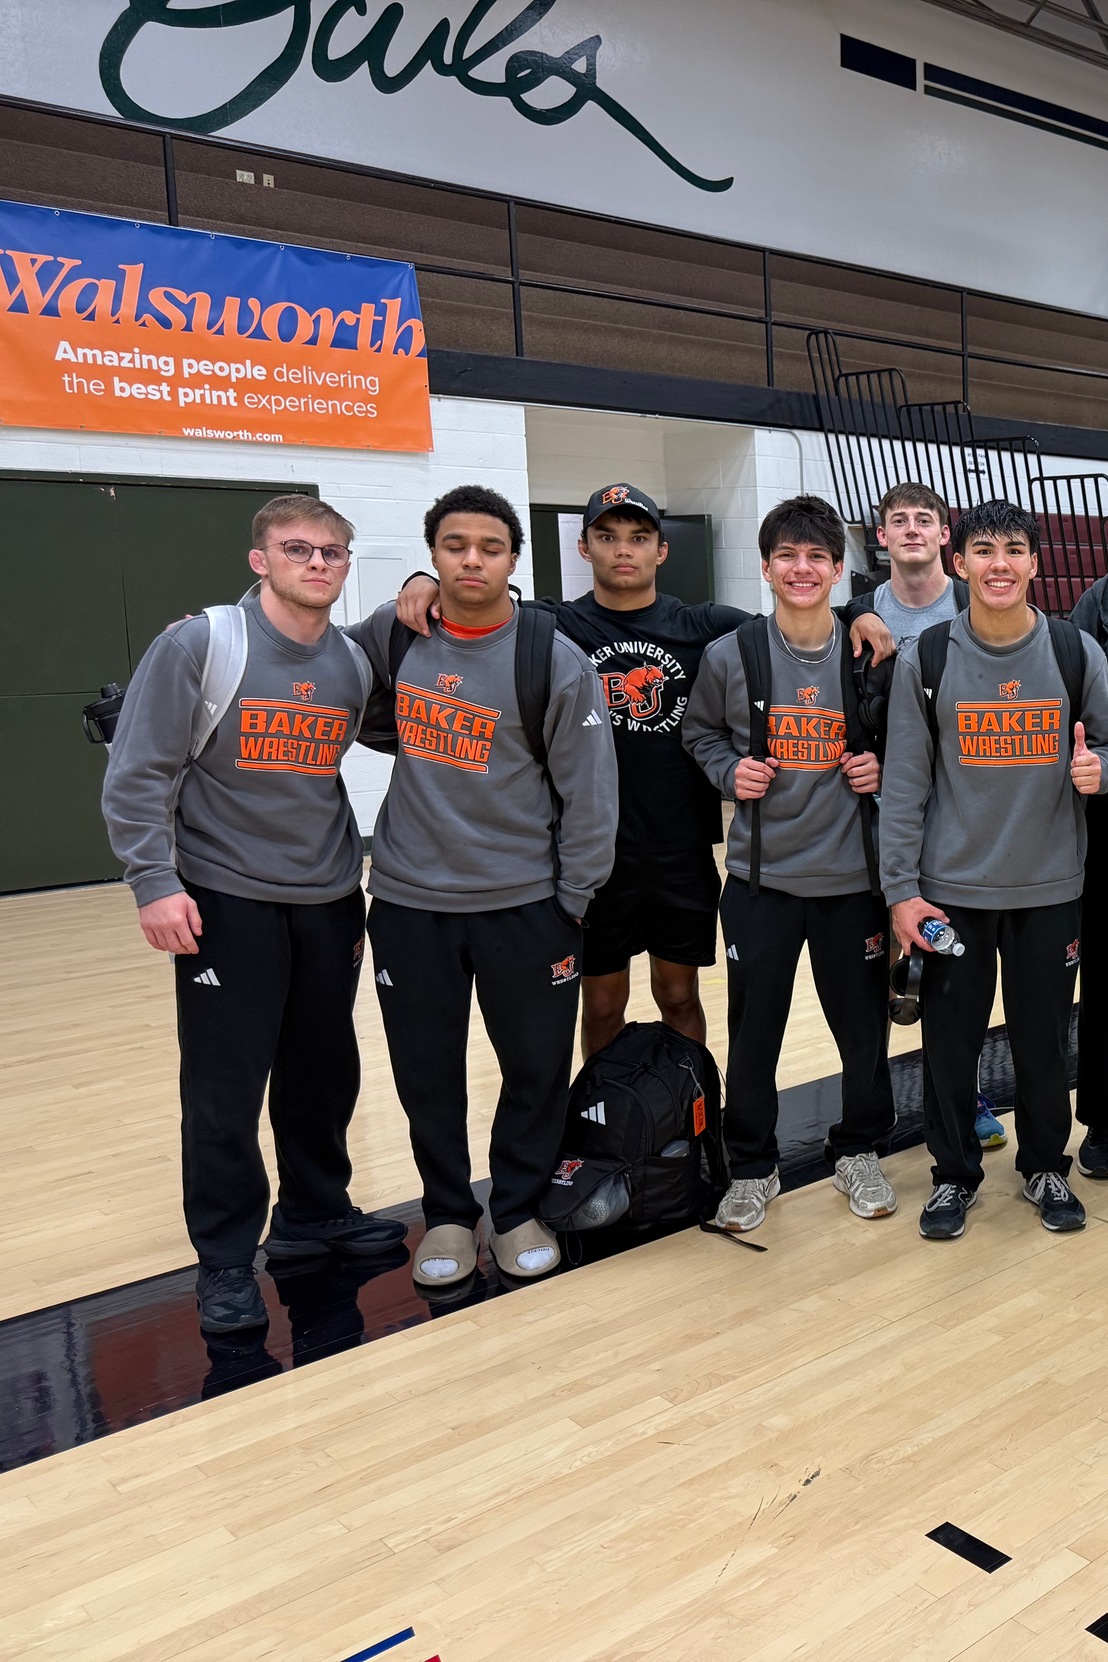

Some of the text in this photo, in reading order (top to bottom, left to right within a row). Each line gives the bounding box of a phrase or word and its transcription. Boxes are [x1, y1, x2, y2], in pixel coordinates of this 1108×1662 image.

[0, 249, 426, 357] Walsworth
[54, 340, 380, 395] Amazing people delivering
[62, 373, 378, 418] the best print experiences
[182, 425, 284, 443] walsworth.com
[588, 641, 687, 680] KER UNIVERSITY
[241, 710, 348, 741] BAKER
[396, 692, 496, 740] BAKER
[957, 710, 1061, 733] BAKER
[240, 736, 341, 766] WRESTLING
[767, 738, 848, 761] WRESTLIN
[959, 733, 1059, 757] WRESTLING
